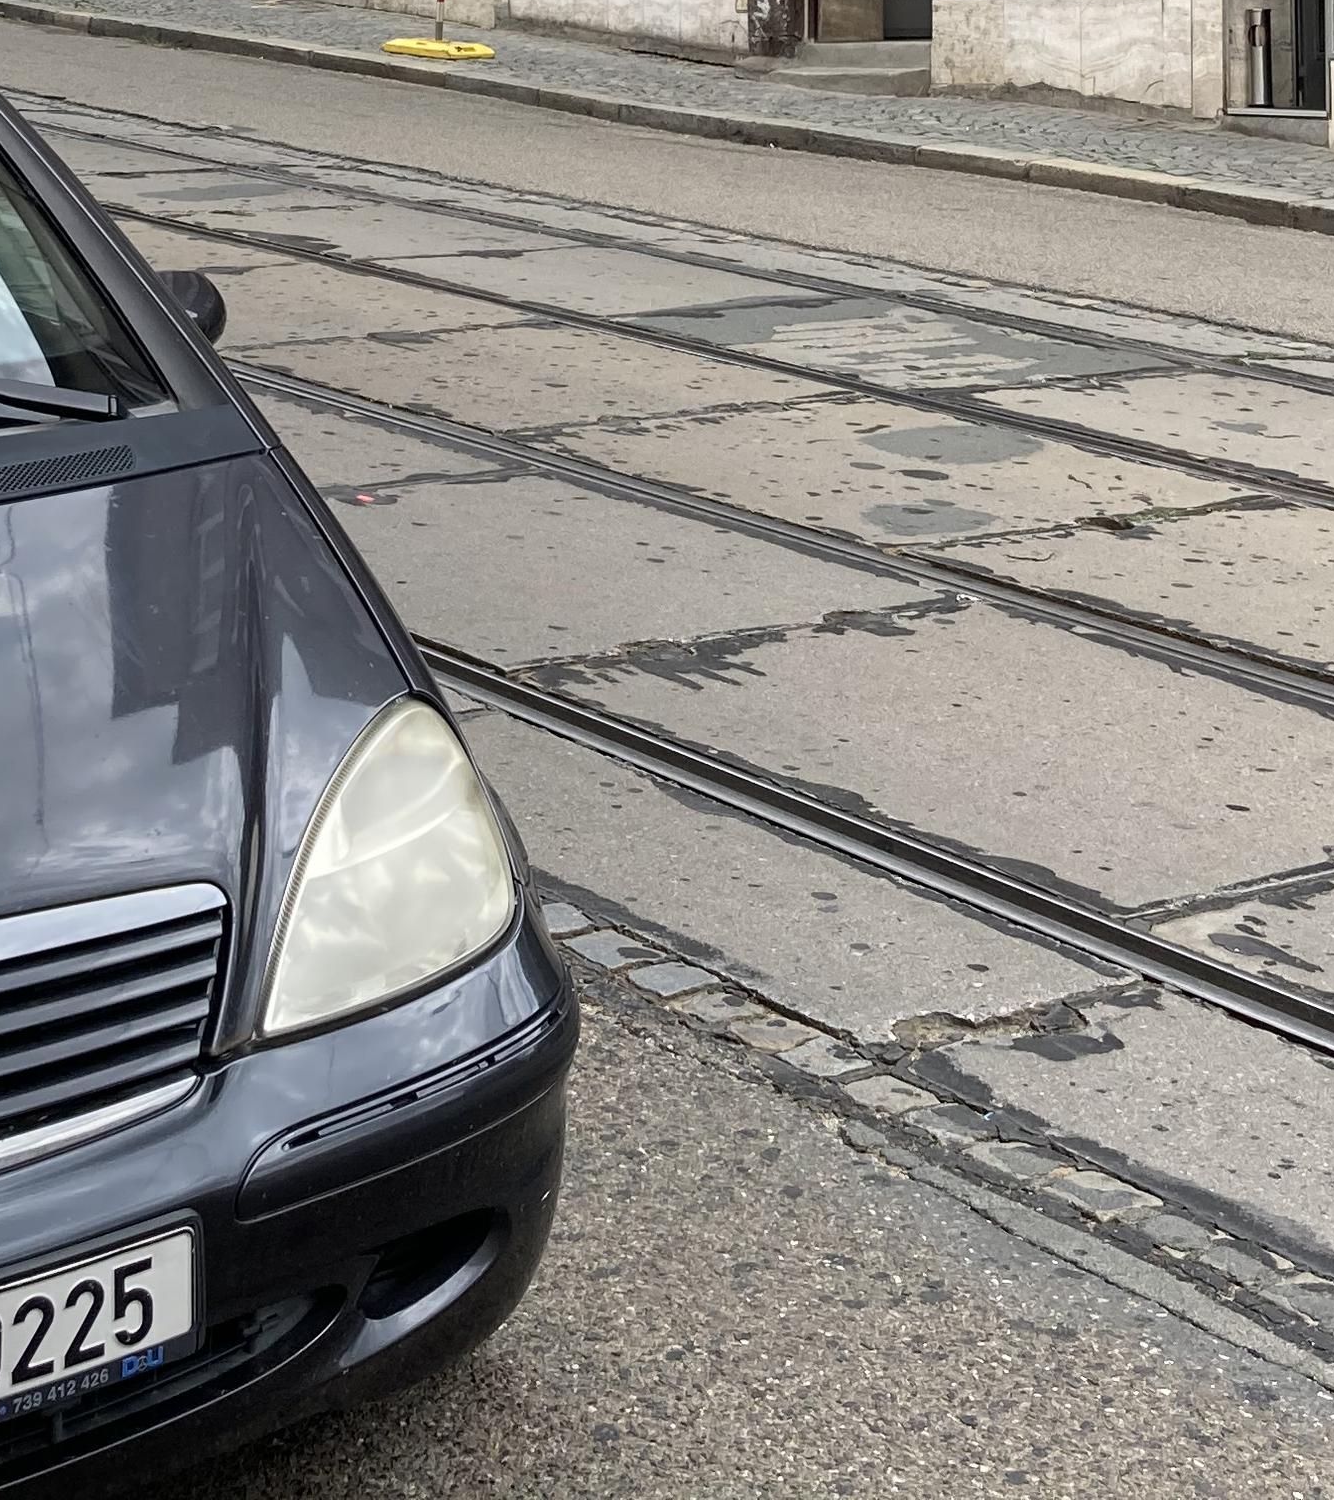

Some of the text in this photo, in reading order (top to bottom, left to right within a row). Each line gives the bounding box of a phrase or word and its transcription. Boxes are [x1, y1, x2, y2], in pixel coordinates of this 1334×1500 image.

[12, 1392, 42, 1414] 739
[47, 1380, 76, 1402] 412
[80, 1369, 109, 1390] 426
